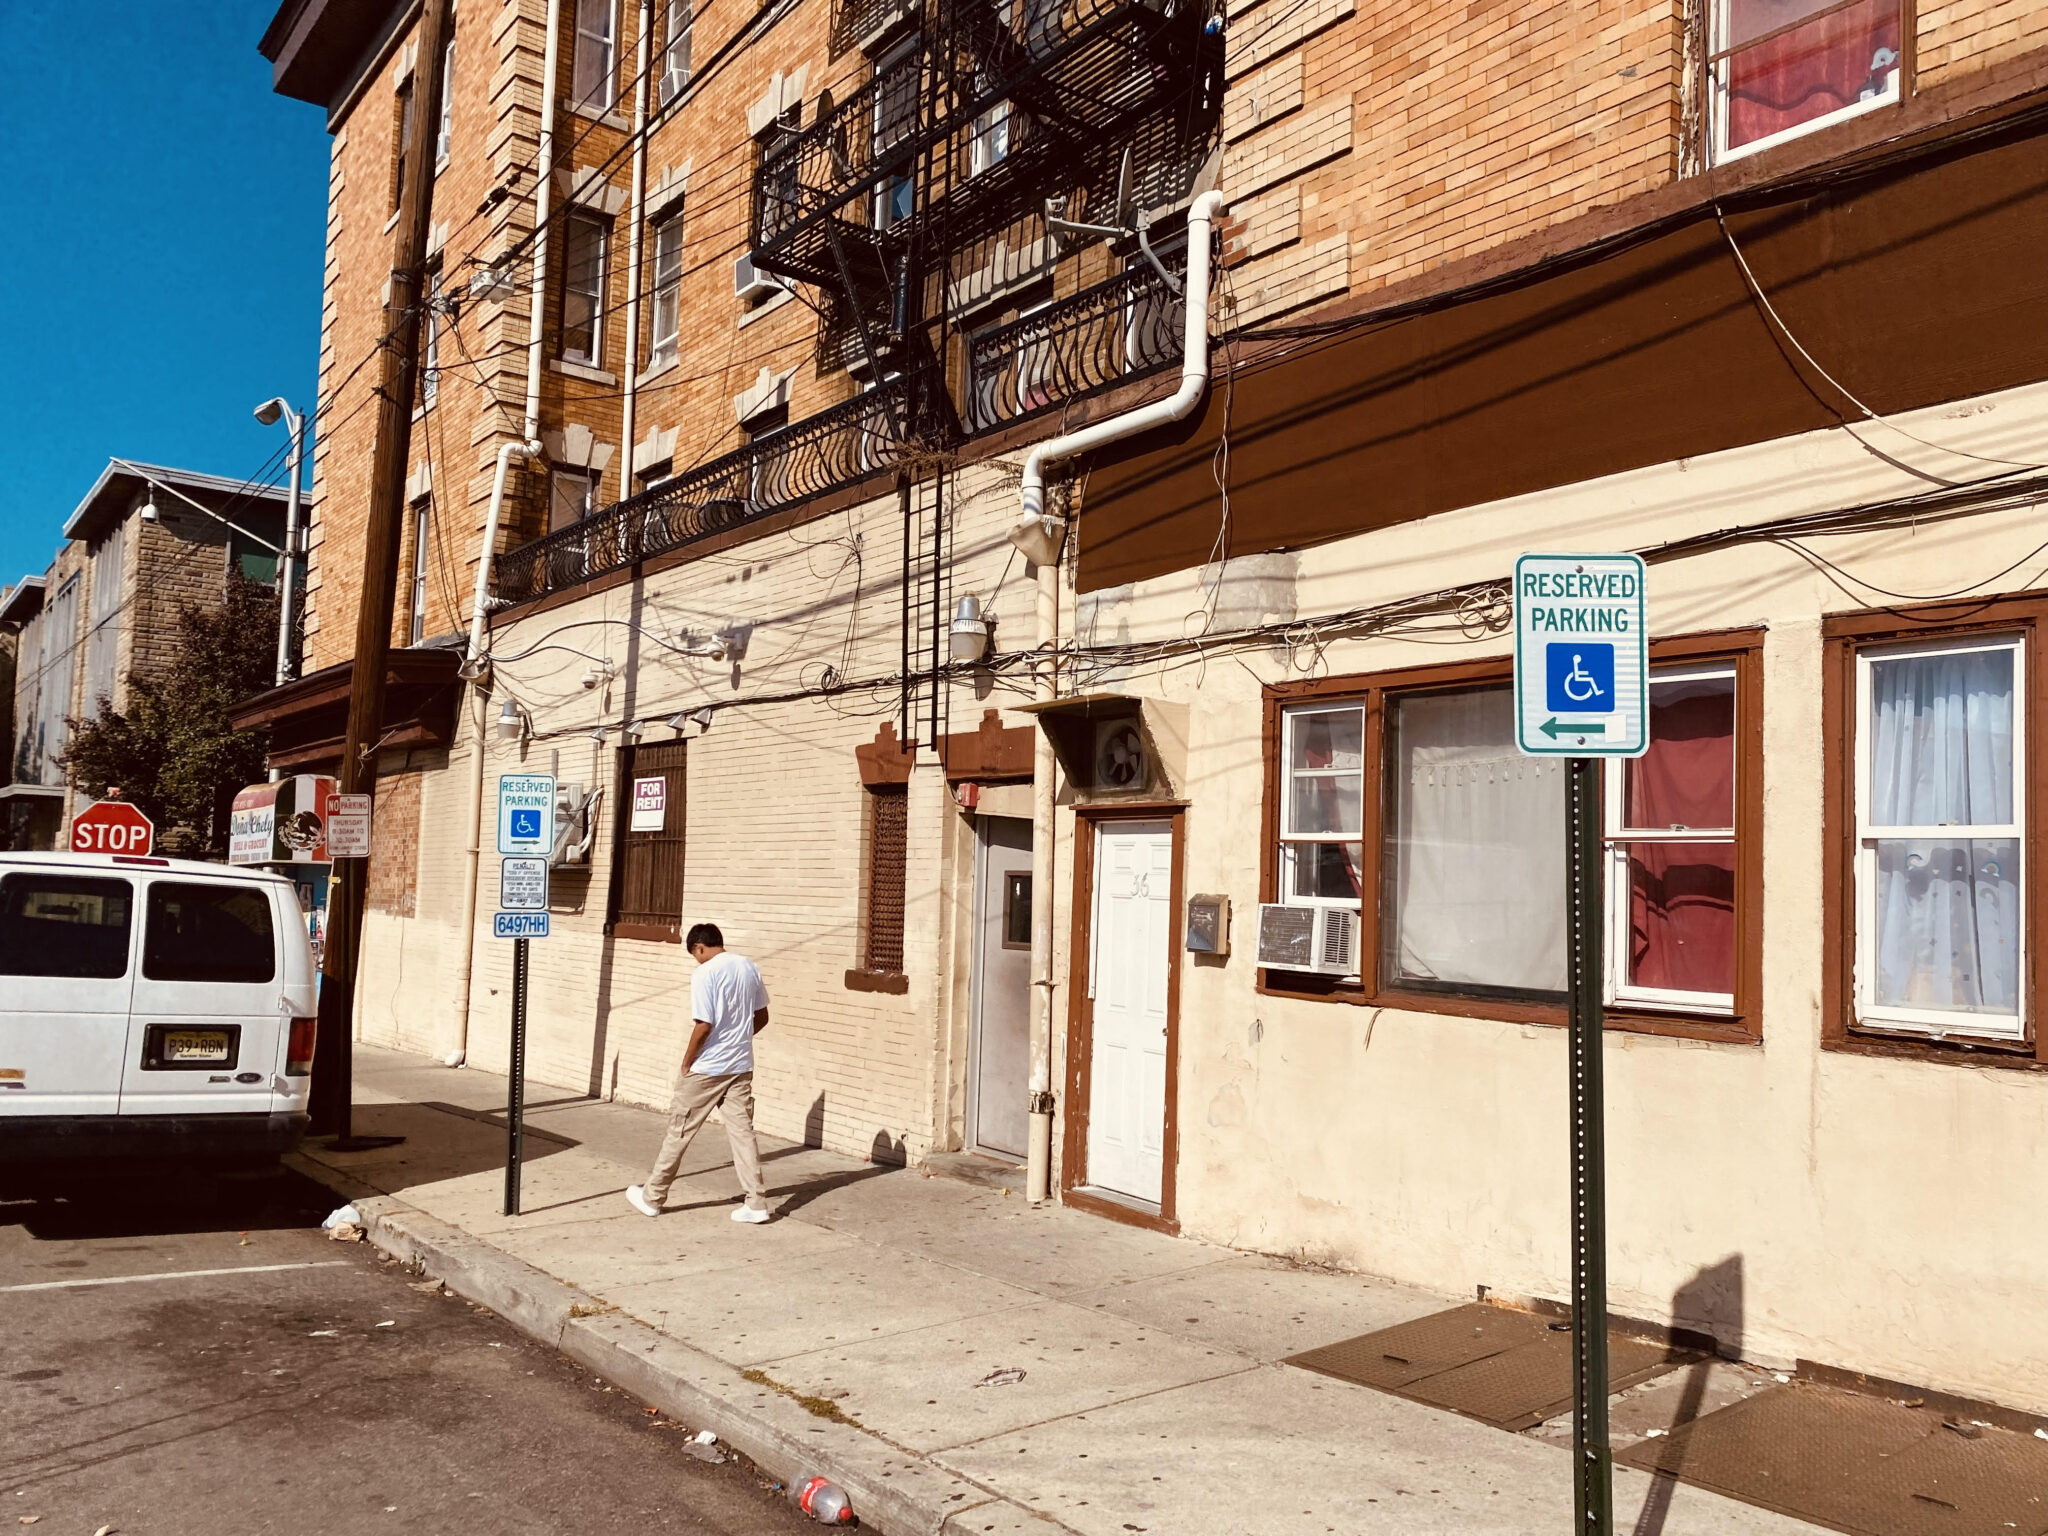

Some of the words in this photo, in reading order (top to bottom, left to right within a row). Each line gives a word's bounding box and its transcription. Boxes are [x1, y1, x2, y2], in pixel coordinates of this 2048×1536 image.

[1524, 573, 1635, 598] RESERVED
[1532, 607, 1629, 632] PARKING
[502, 781, 552, 793] RESERVED
[640, 782, 661, 796] FOR
[328, 799, 340, 812] NO
[340, 801, 368, 810] PARKING
[505, 795, 548, 807] PARKING
[636, 796, 664, 810] RENT
[249, 814, 273, 838] Chely
[75, 823, 147, 850] STOP
[1130, 872, 1150, 898] 36
[498, 916, 546, 933] 6497HH
